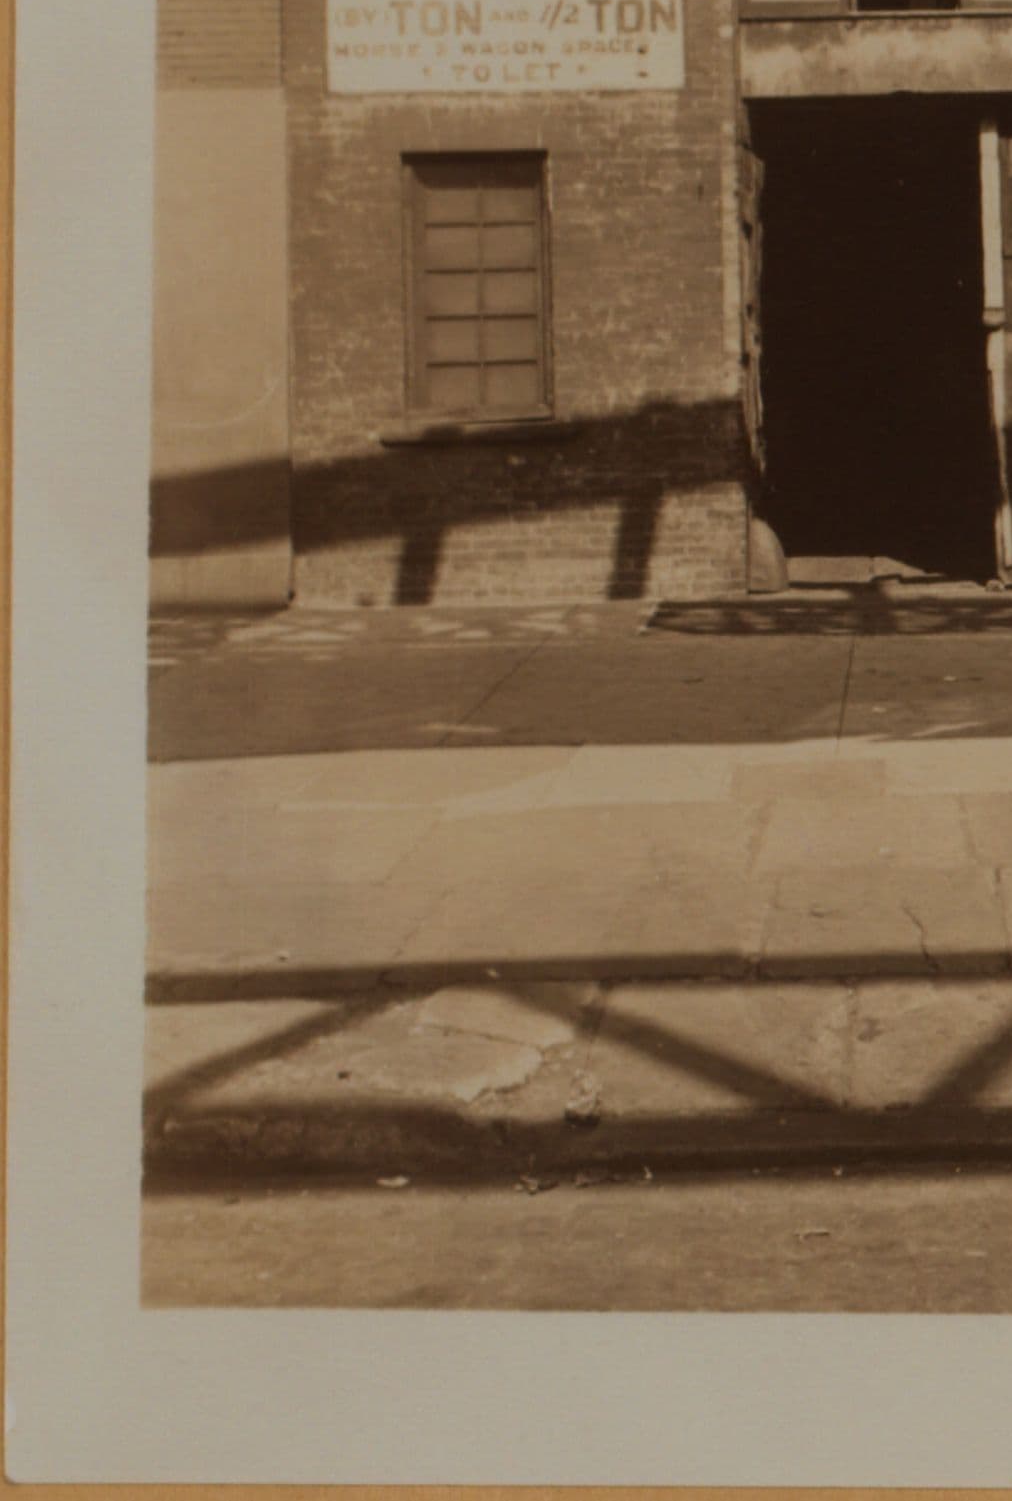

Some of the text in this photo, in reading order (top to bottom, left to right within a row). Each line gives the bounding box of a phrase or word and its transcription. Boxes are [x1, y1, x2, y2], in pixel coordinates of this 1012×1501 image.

[389, 0, 483, 36] TON
[462, 40, 546, 56] WAGON
[451, 62, 562, 84] TO LET
